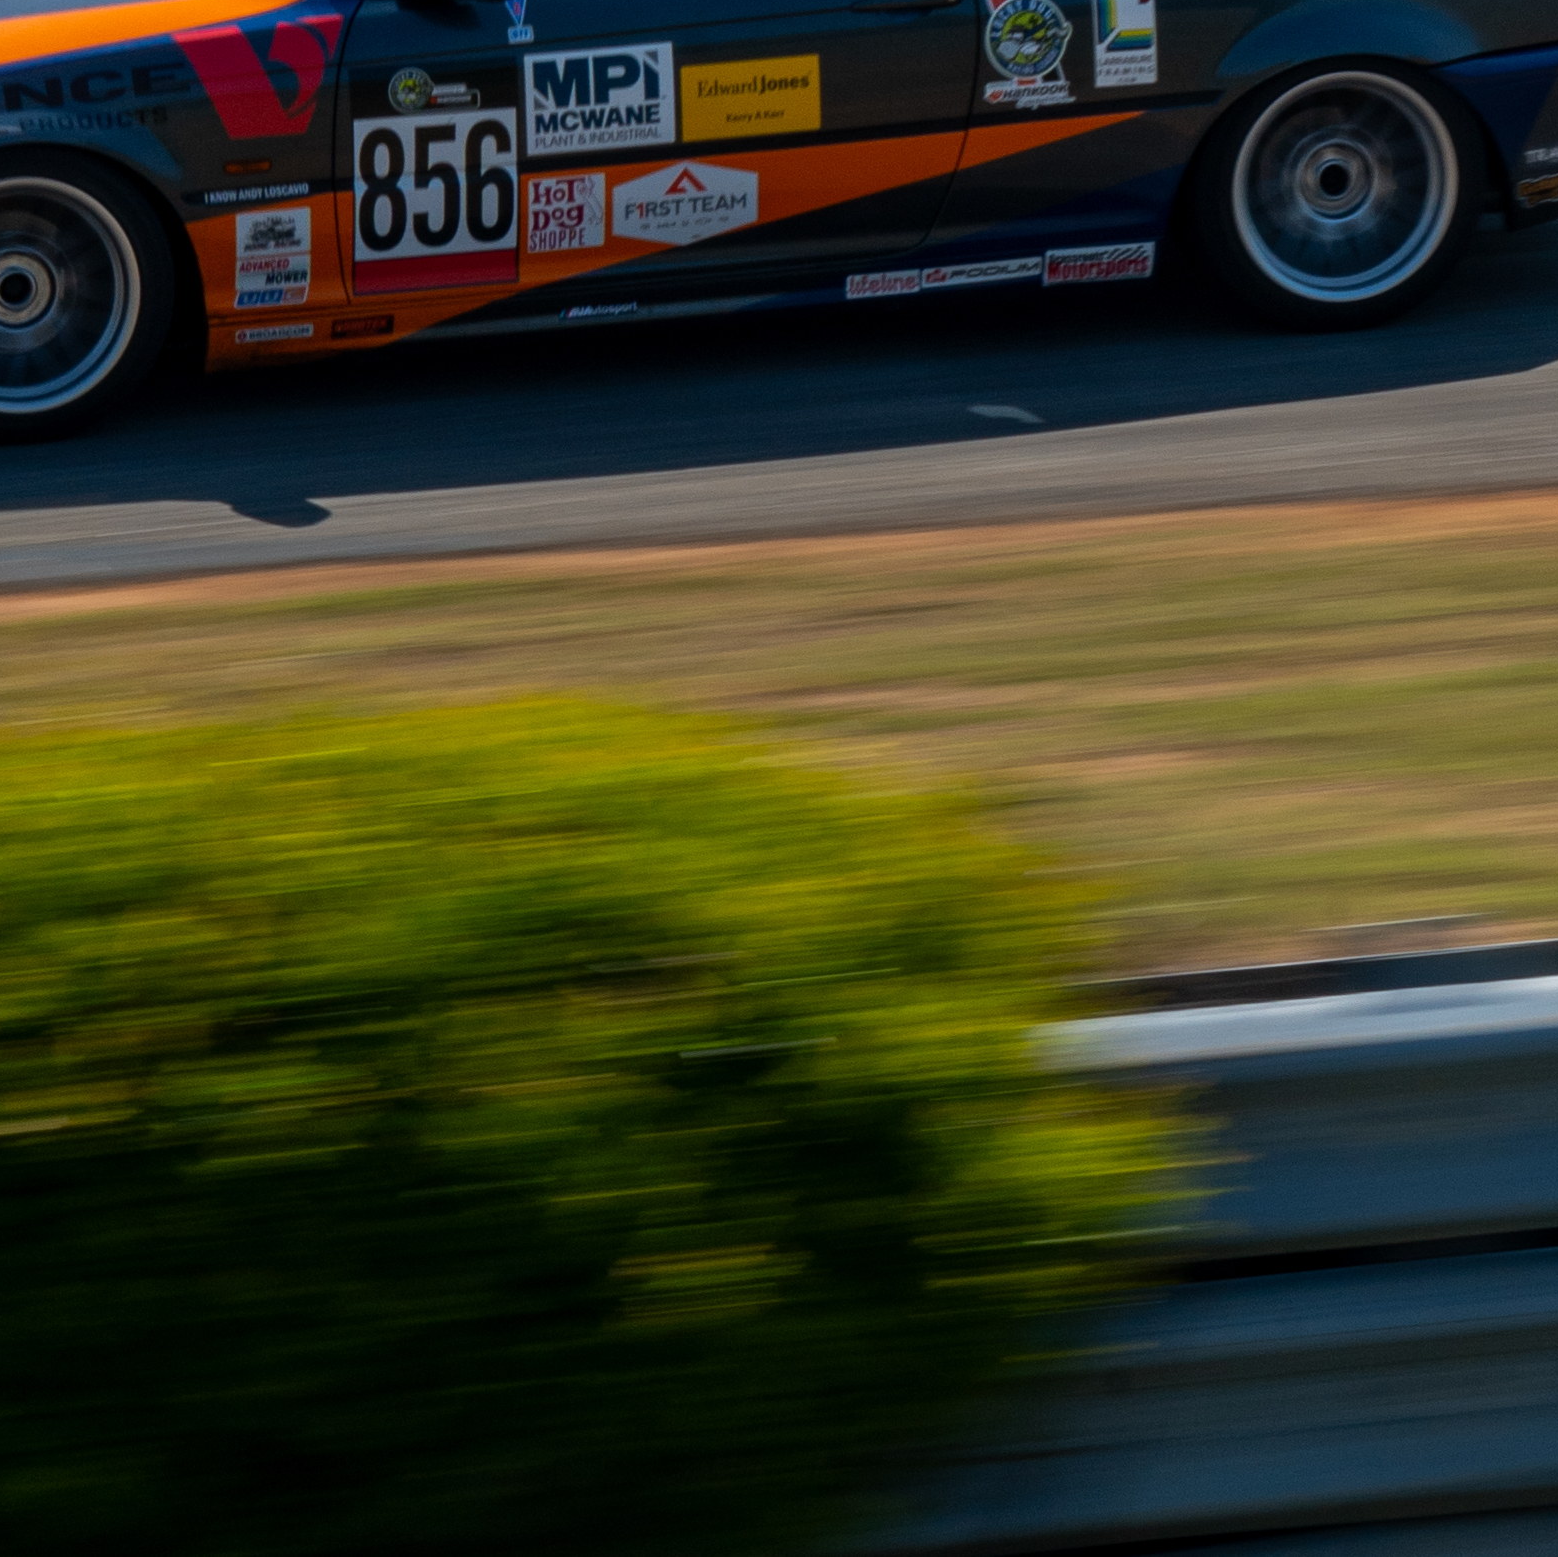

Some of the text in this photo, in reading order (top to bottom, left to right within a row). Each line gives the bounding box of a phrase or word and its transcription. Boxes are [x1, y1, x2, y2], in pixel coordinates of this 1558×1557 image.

[697, 74, 810, 98] Edward Jones
[20, 105, 168, 133] PRODUCTS
[535, 102, 661, 135] MCWANE
[535, 133, 574, 149] PLANT
[592, 126, 660, 144] INDUSTRIAL
[209, 190, 237, 204] KNOW
[239, 187, 263, 201] ANDY
[358, 119, 514, 252] 856
[688, 193, 748, 214] TEAM
[529, 227, 586, 252] SHOPPE
[239, 258, 290, 274] ADVANCED
[949, 260, 1041, 279] PODIUM
[265, 270, 308, 286] MOWER
